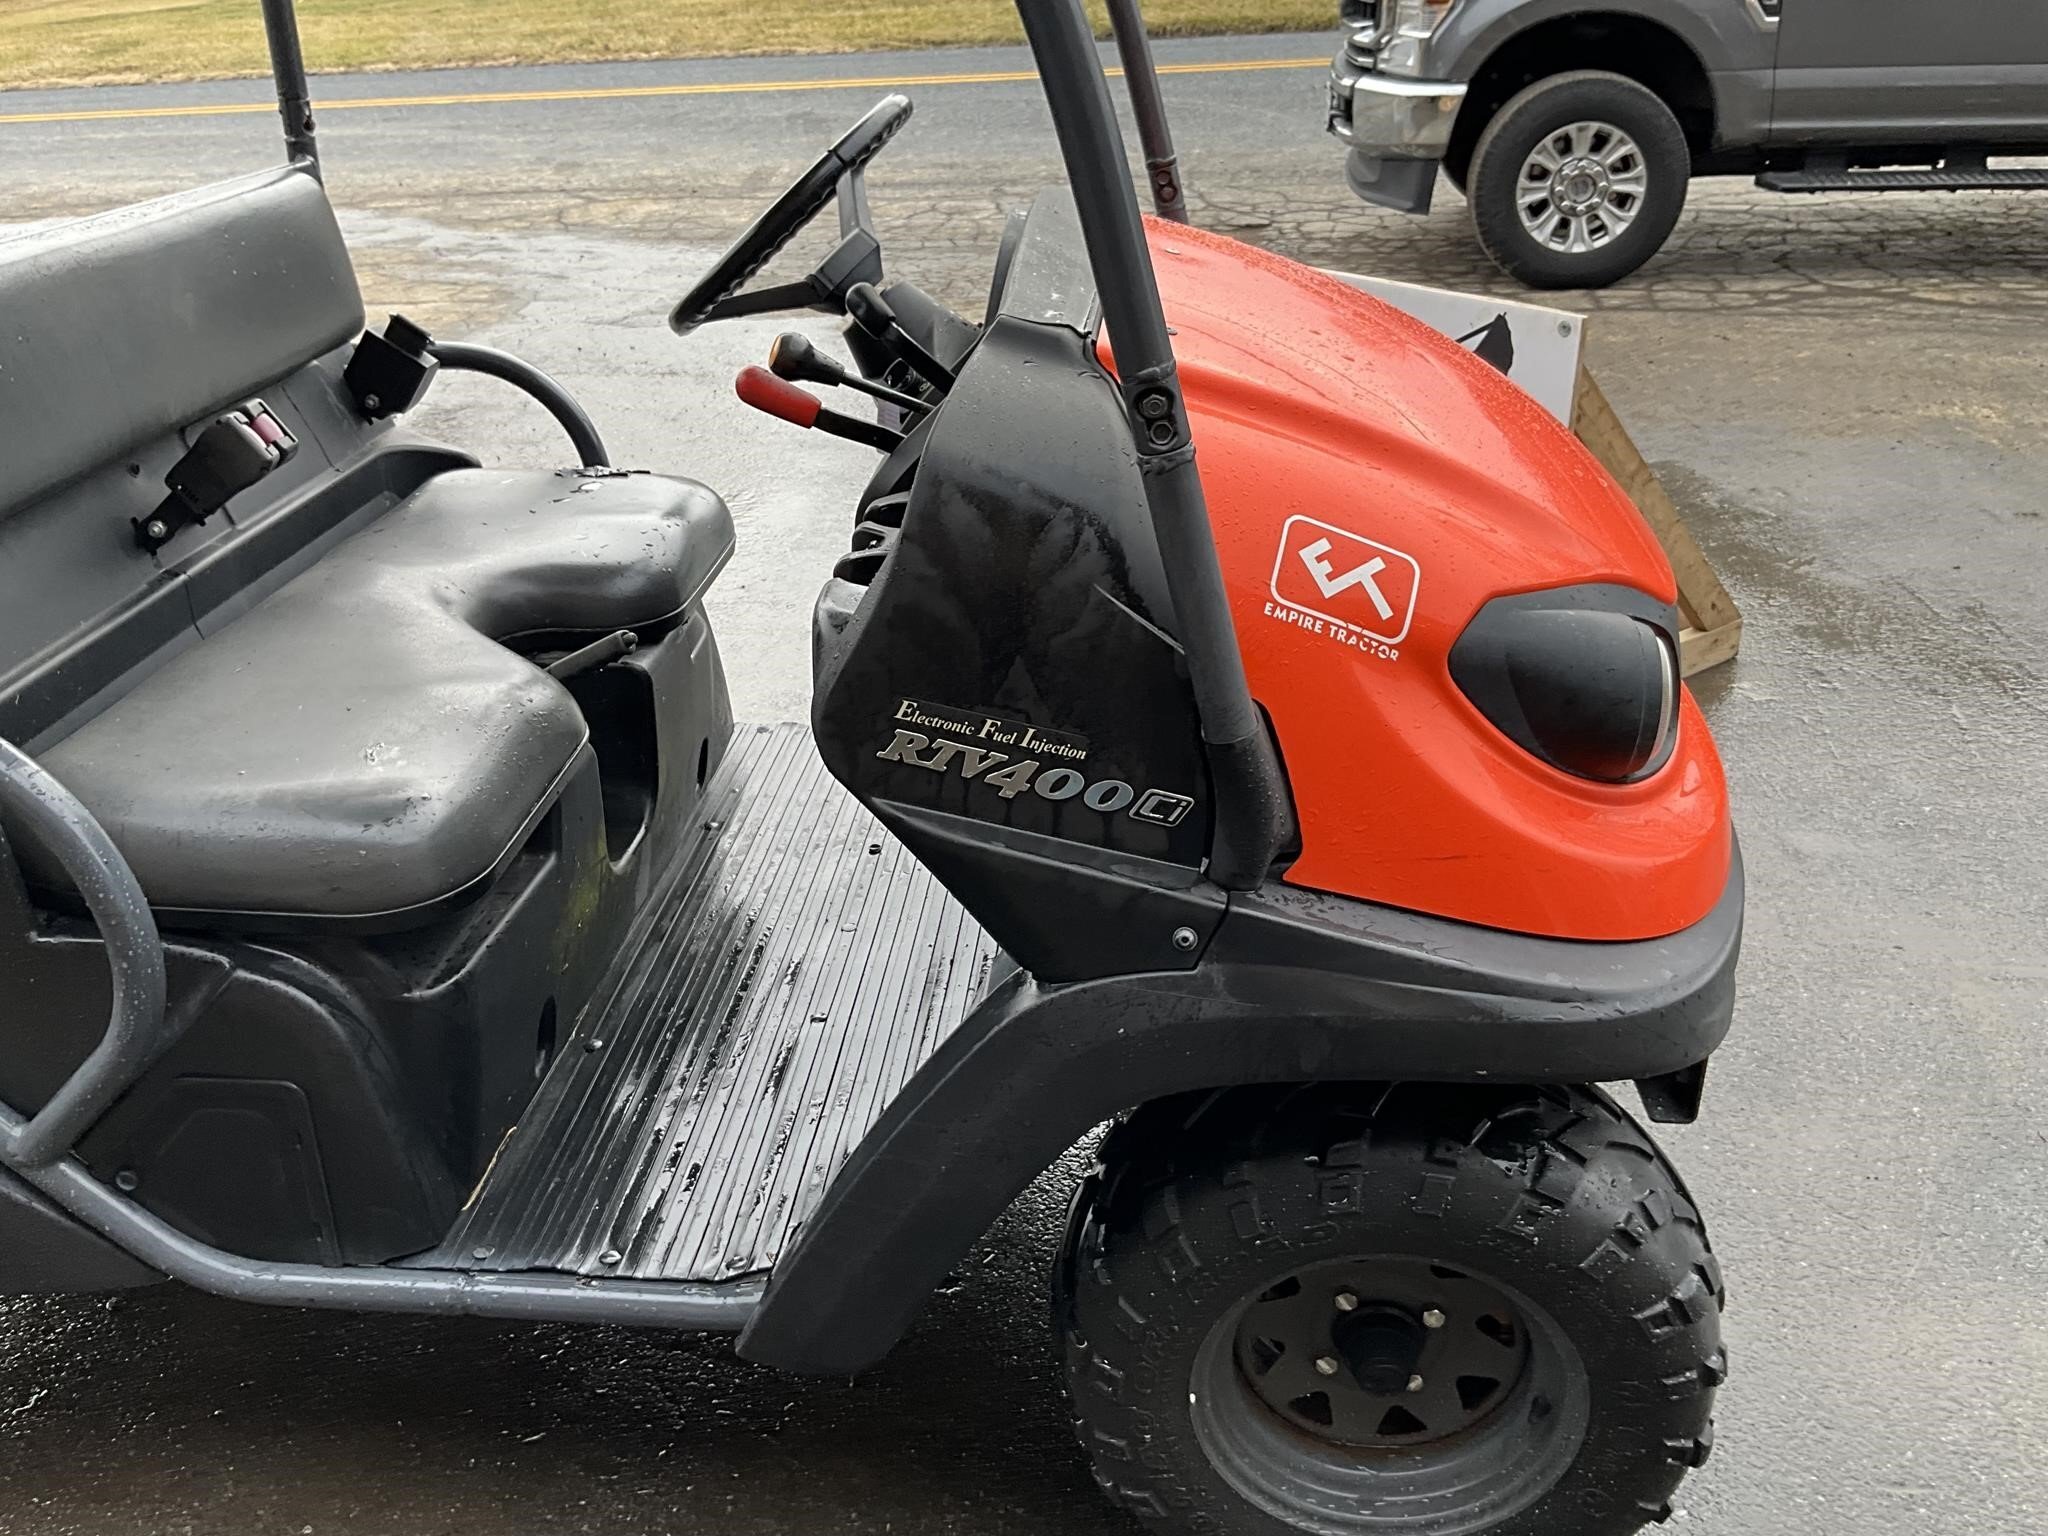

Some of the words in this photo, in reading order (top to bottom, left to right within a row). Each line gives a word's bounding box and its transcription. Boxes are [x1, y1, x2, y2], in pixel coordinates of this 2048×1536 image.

[1298, 537, 1394, 621] ET
[1263, 602, 1324, 634] EMPIRE
[1329, 624, 1399, 662] TRACTOR
[893, 700, 975, 735] Electronic
[977, 718, 1018, 746] Fuel
[1018, 727, 1087, 761] Injection
